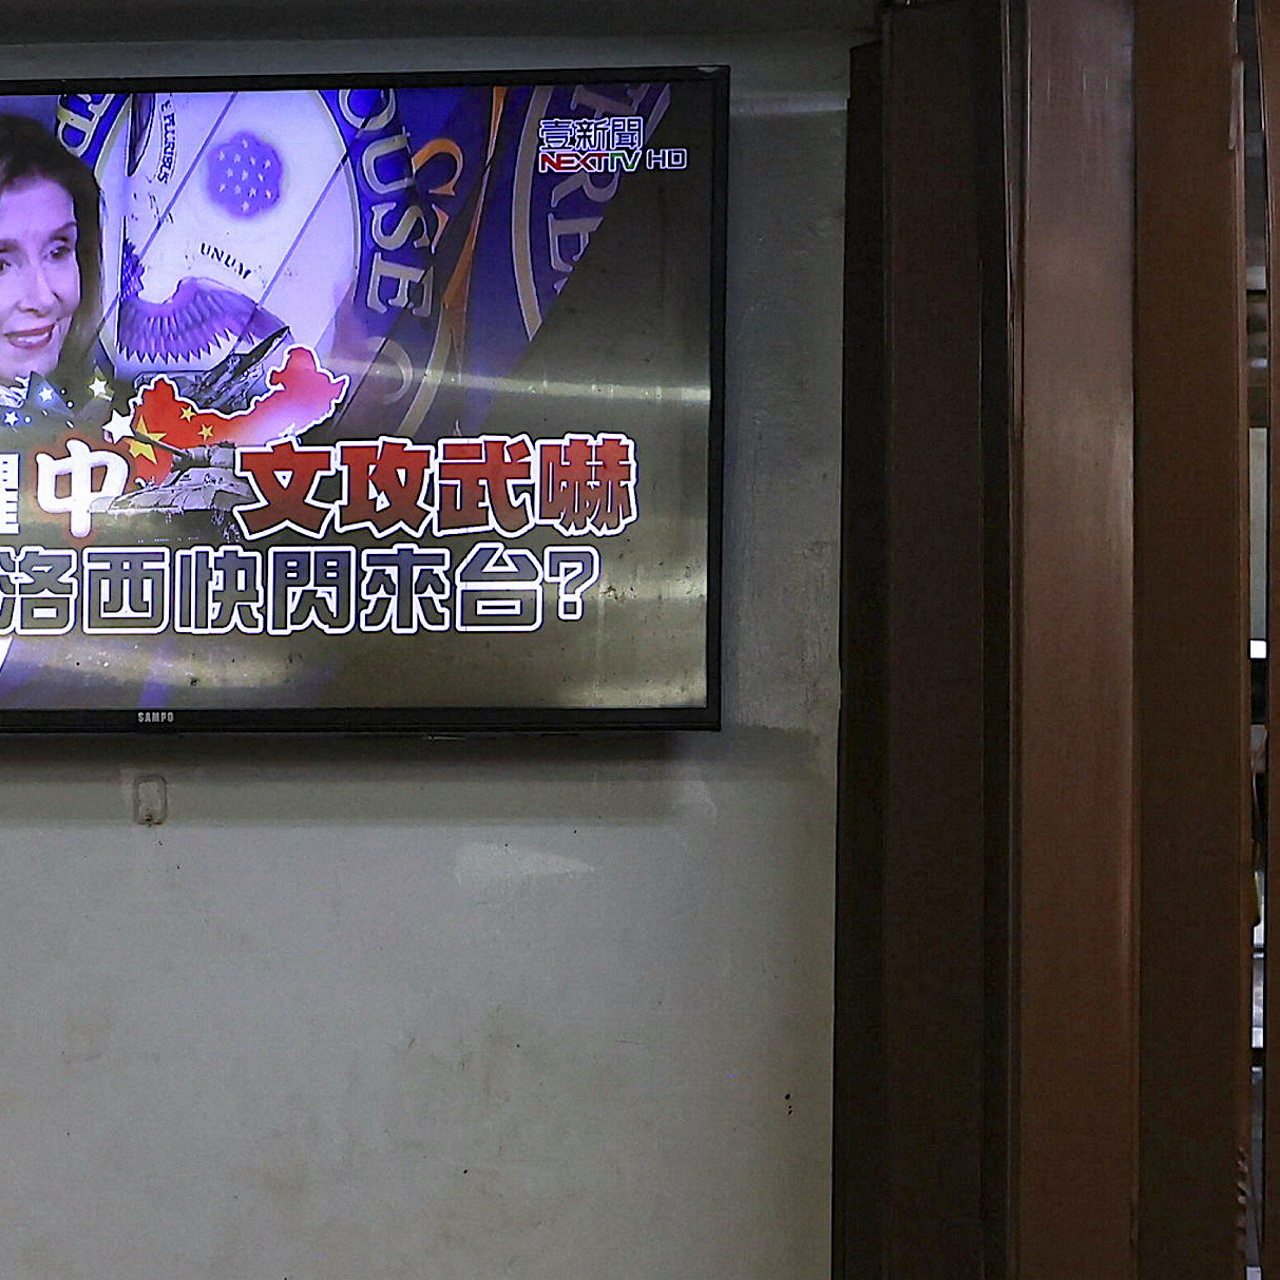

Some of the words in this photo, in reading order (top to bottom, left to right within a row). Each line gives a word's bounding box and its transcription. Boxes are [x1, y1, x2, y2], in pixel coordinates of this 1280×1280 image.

[538, 115, 643, 151] 壹新聞
[646, 148, 688, 170] HD
[236, 433, 639, 540] 文攻武嚇
[137, 711, 174, 723] SAMPO
